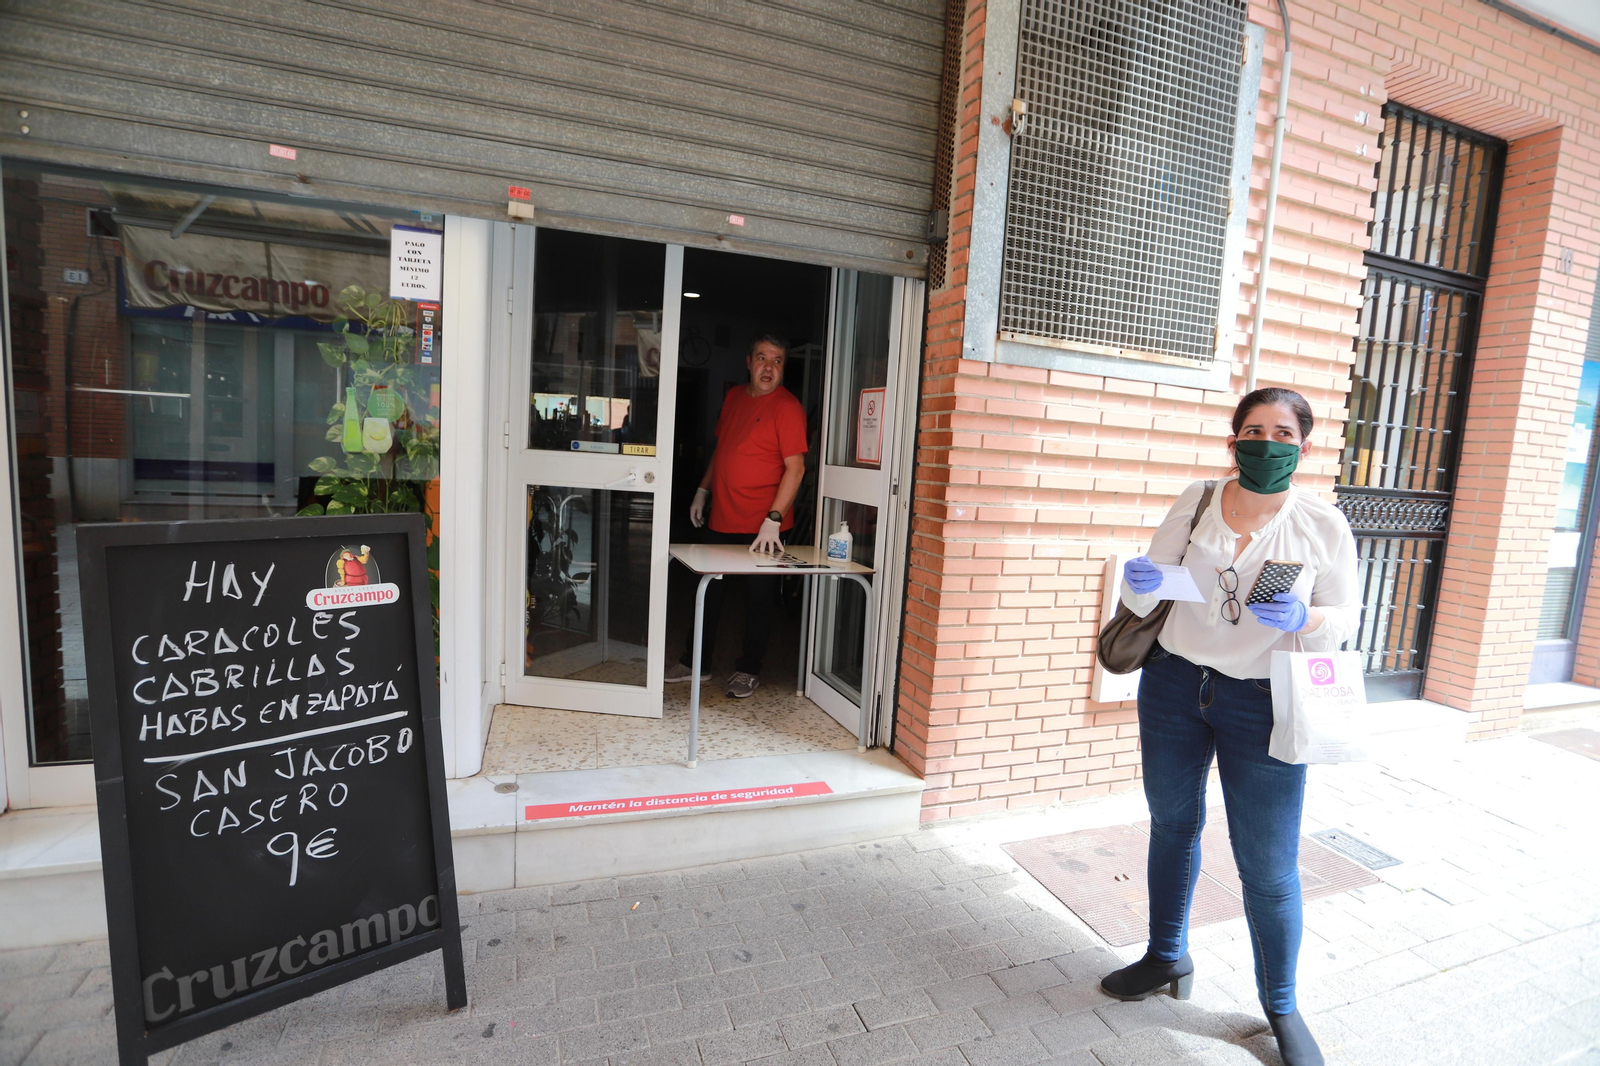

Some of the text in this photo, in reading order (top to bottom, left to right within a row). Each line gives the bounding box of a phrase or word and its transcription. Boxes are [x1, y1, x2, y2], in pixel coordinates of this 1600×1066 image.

[398, 256, 432, 264] TARJETA
[1559, 247, 1574, 274] 10
[143, 260, 330, 309] Cruzcampo
[630, 446, 649, 454] TIRAR
[183, 560, 275, 606] HAY
[313, 589, 394, 606] Cruzcampo
[132, 611, 360, 664] CARACOLES
[133, 647, 355, 704] CABRILLAS
[1323, 686, 1355, 698] ROSA
[139, 704, 247, 741] HABAS
[156, 728, 413, 810] SAN JACOBO
[190, 782, 349, 836] CASERO
[568, 786, 794, 813] Mantén la distancia de seguridad
[266, 828, 340, 886] 9€
[141, 894, 441, 1022] Cruzcampo
